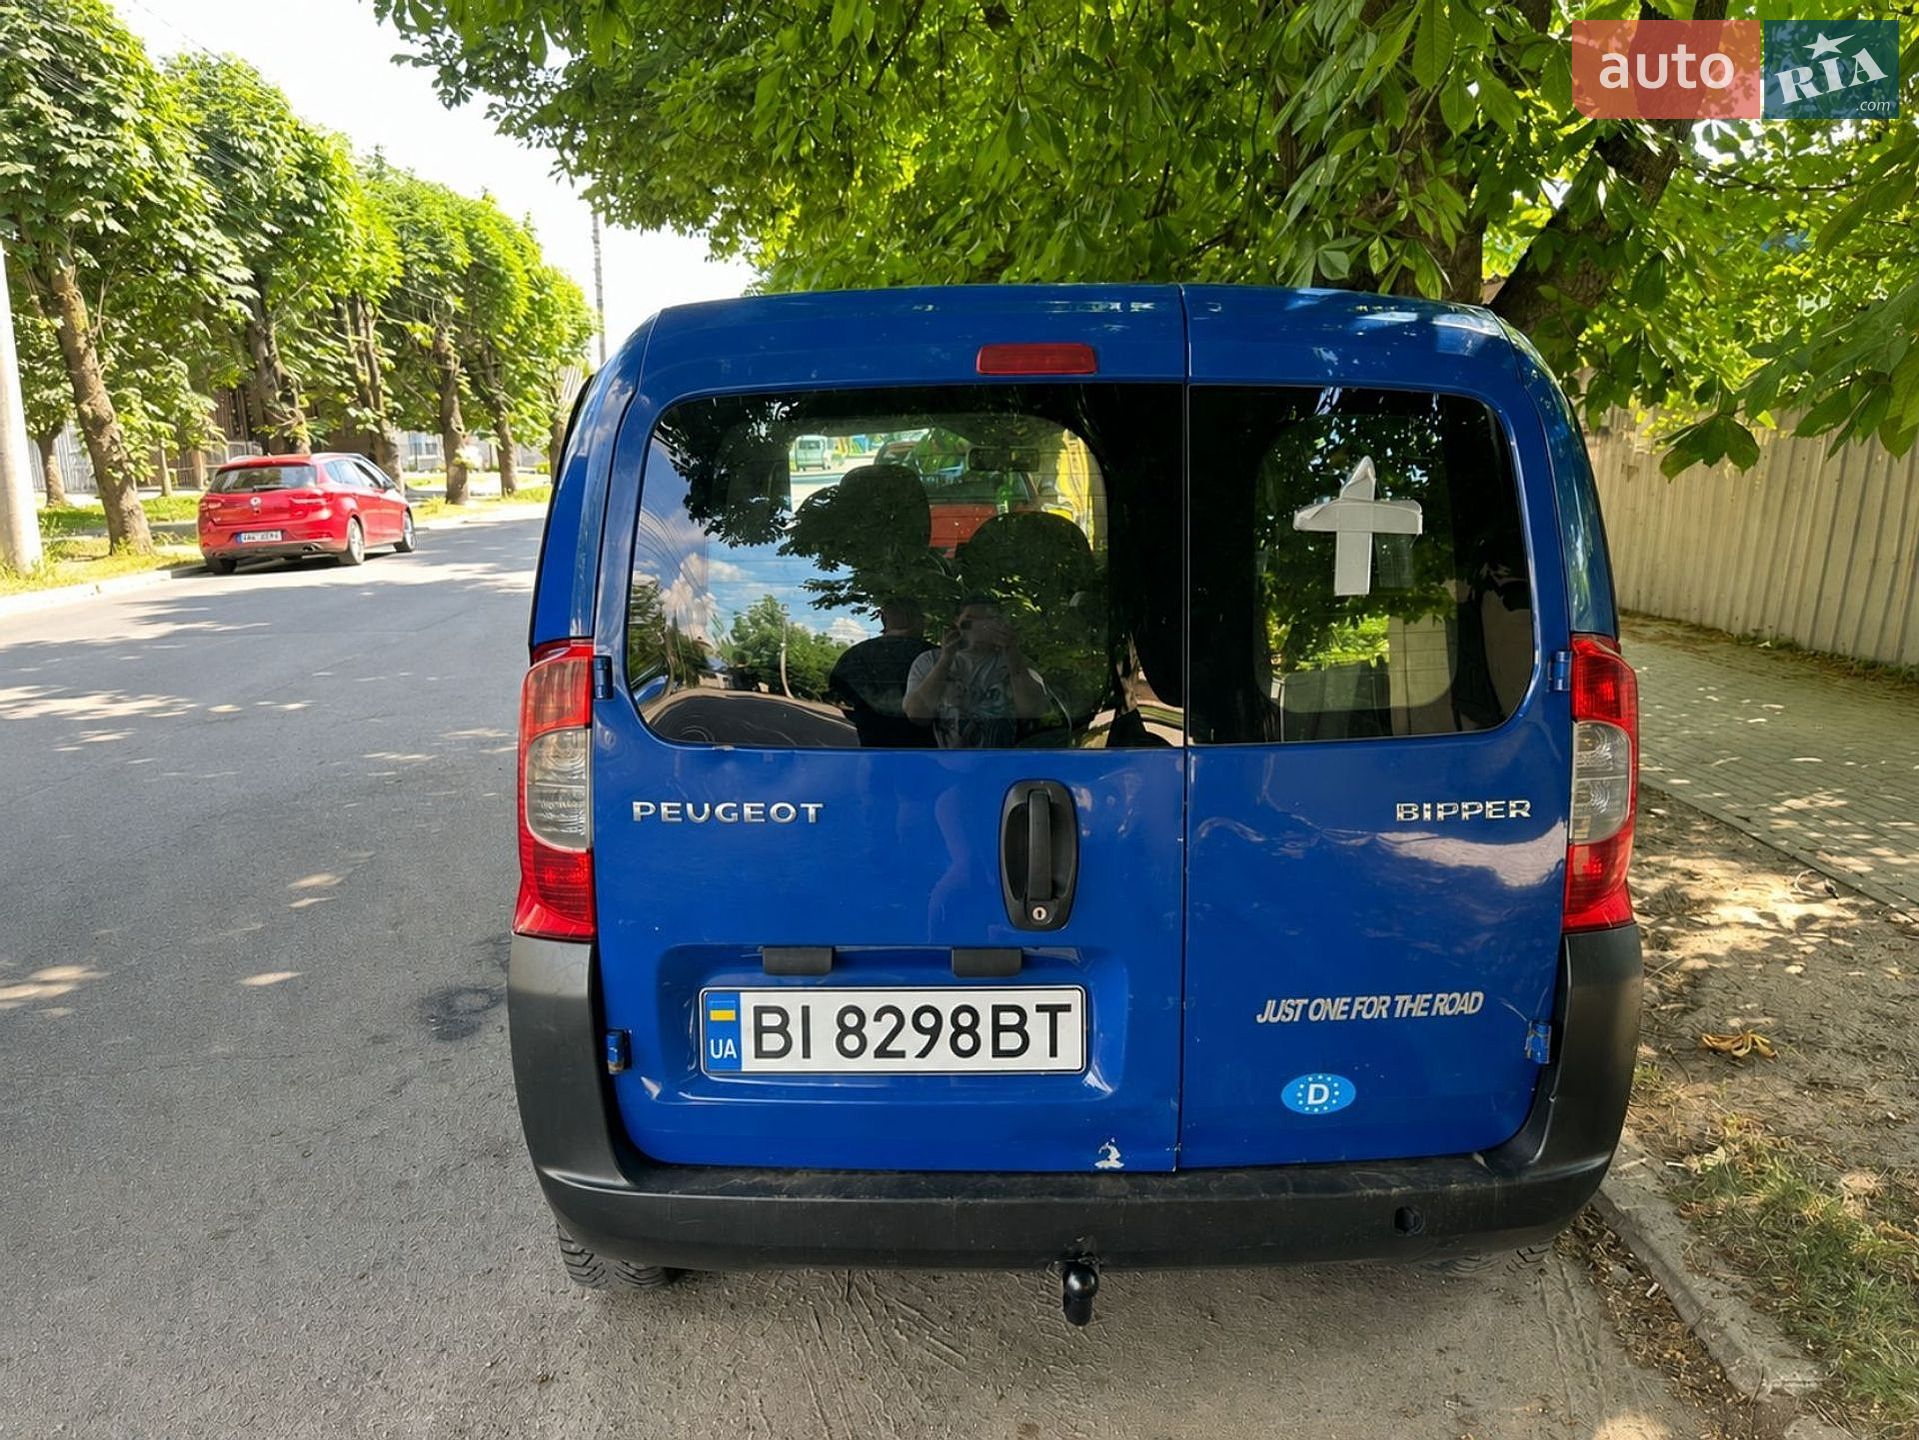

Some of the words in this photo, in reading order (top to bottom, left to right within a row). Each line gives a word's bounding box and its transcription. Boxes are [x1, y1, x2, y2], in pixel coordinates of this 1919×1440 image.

[632, 801, 824, 824] PEUGEOT
[1396, 799, 1532, 822] BIPPER
[1256, 999, 1309, 1024] JUST
[1308, 996, 1352, 1021] ONE
[1350, 995, 1392, 1020] FOR
[1393, 993, 1432, 1018] THE
[1431, 991, 1485, 1017] ROAD
[752, 1005, 812, 1060] BI
[835, 1003, 1072, 1060] 8298BT
[710, 1039, 737, 1060] UA
[1306, 1083, 1330, 1105] D
